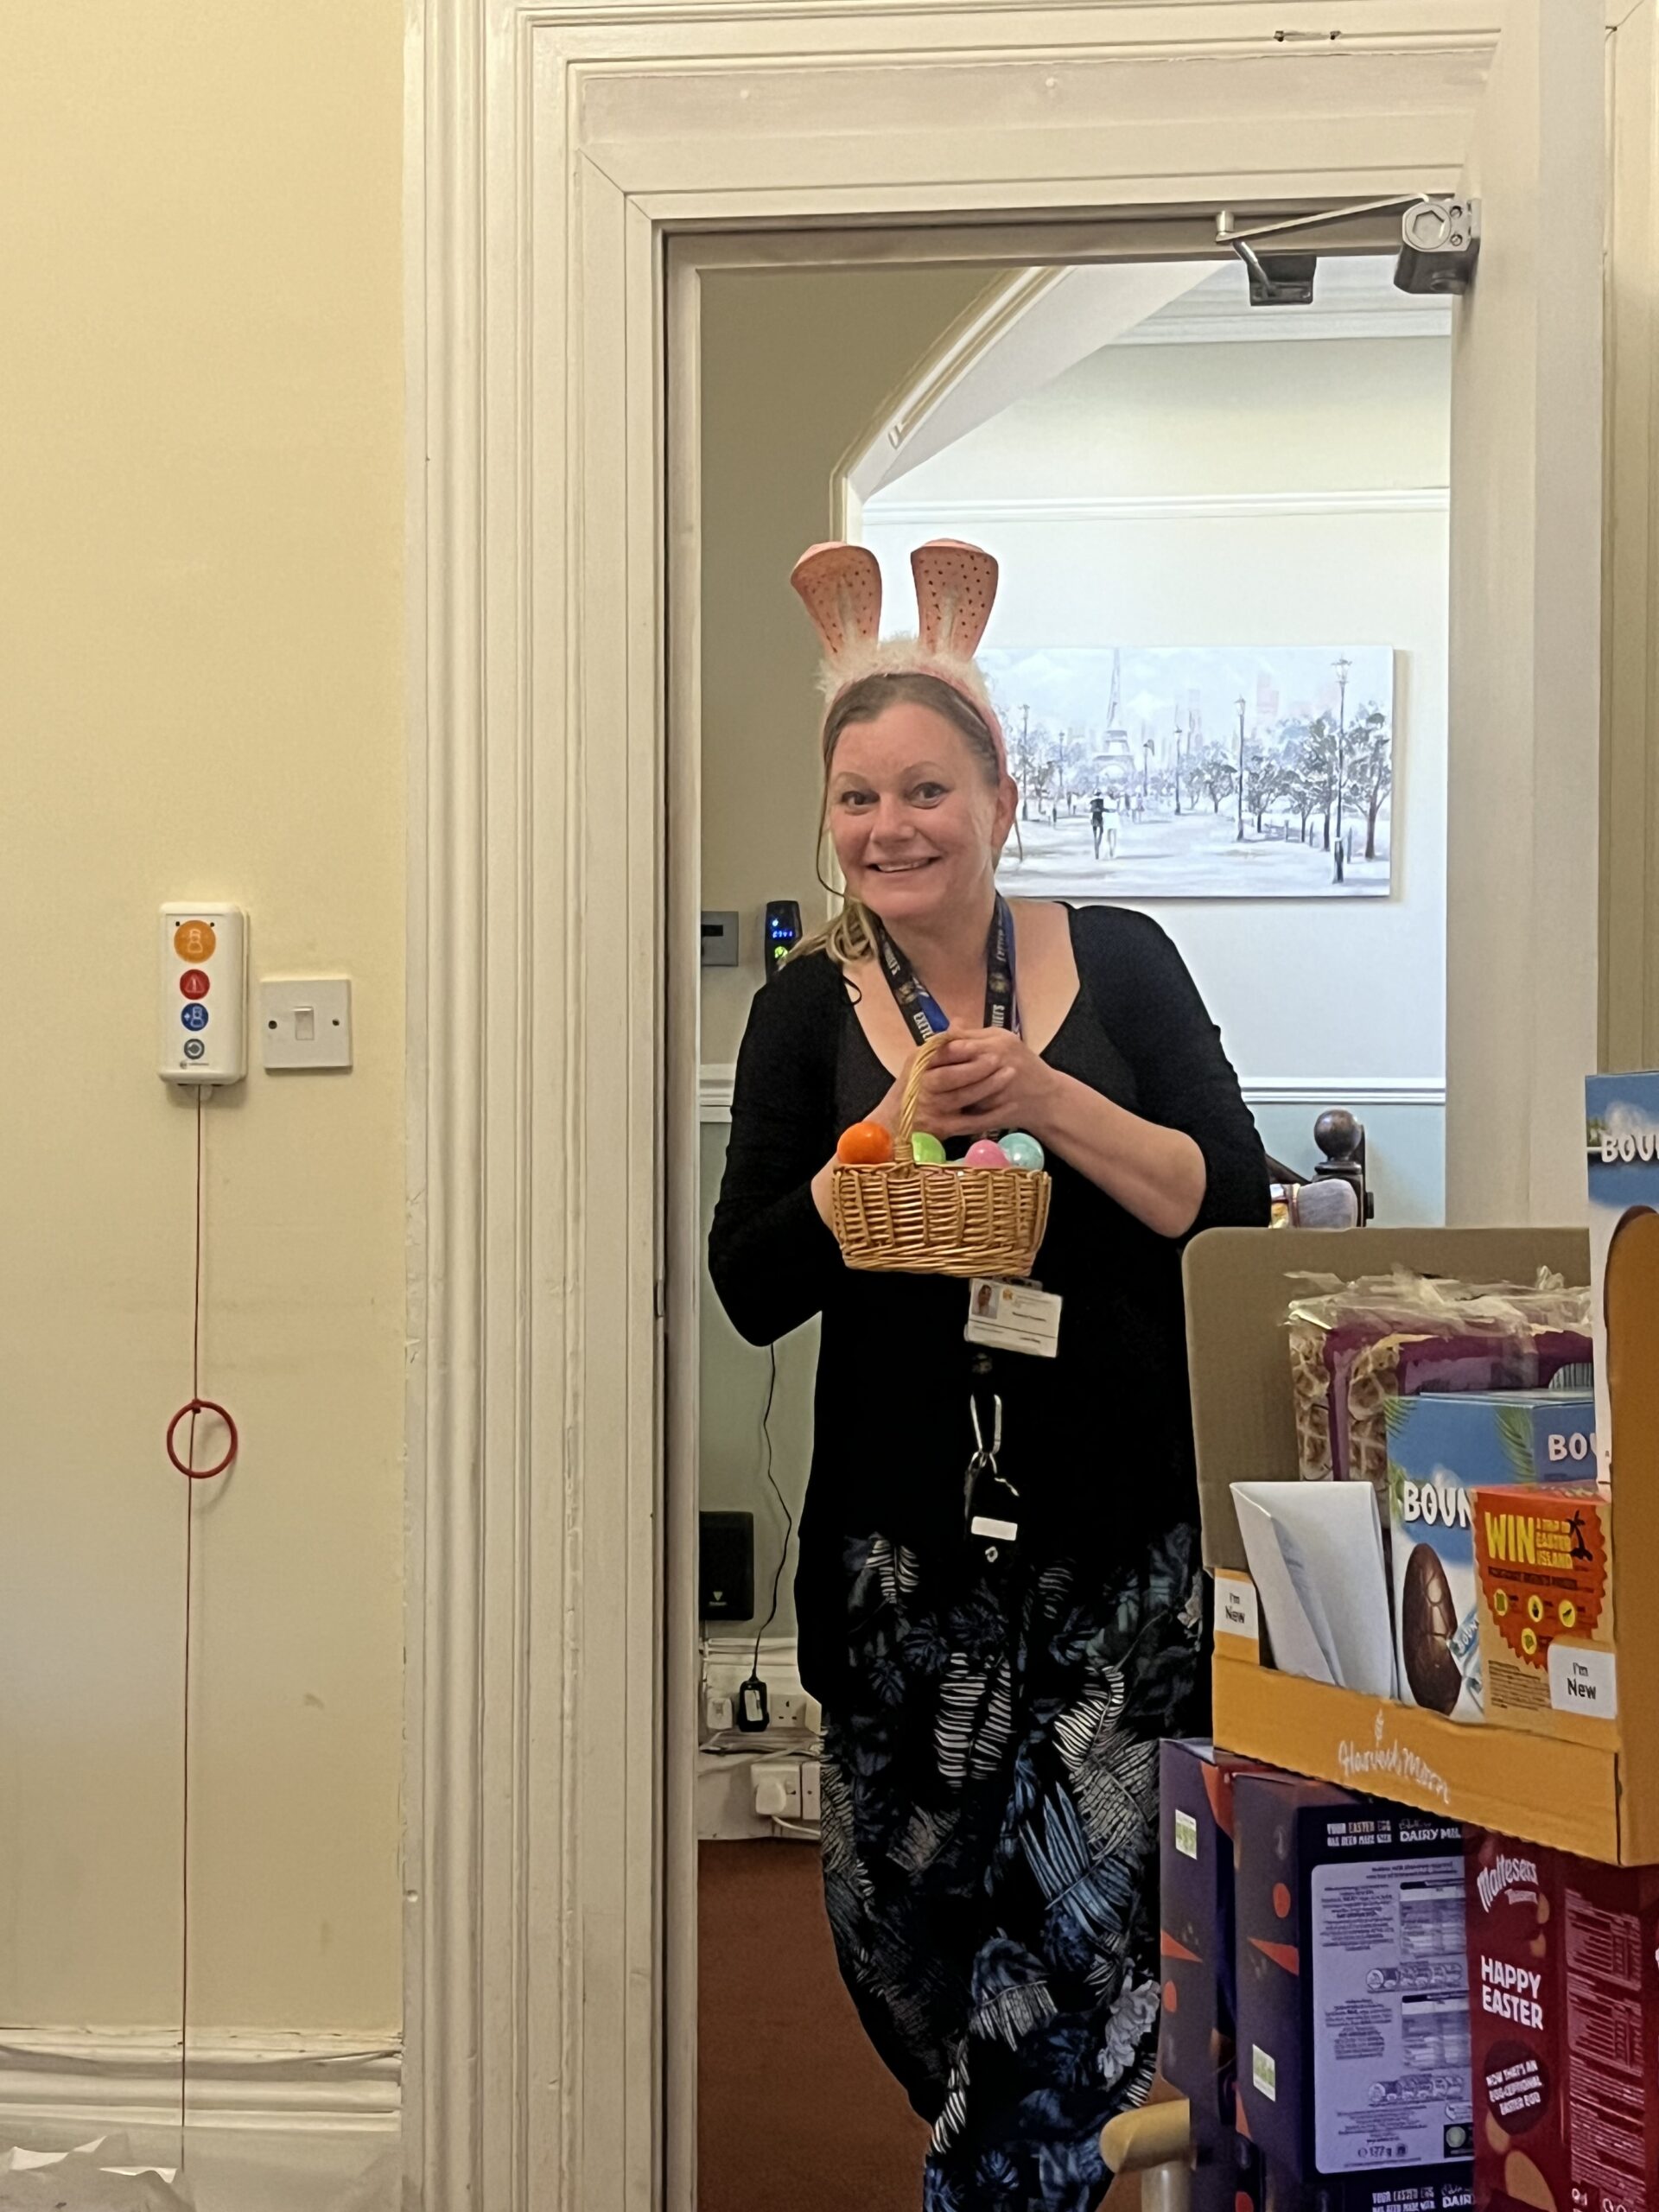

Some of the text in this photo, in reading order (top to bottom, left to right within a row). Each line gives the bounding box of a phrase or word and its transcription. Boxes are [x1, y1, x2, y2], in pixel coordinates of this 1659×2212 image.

[1600, 1129, 1659, 1164] BOU
[1484, 1510, 1535, 1566] WIN
[1224, 1605, 1246, 1624] New
[1572, 1662, 1590, 1677] I'm
[1567, 1677, 1597, 1700] New
[1349, 1821, 1375, 1834] EASTER
[1400, 1828, 1439, 1842] DAIRY
[1477, 1854, 1539, 1913] Maltesers
[1480, 1955, 1541, 1999] HAPPY
[1482, 1984, 1544, 2031] EASTER
